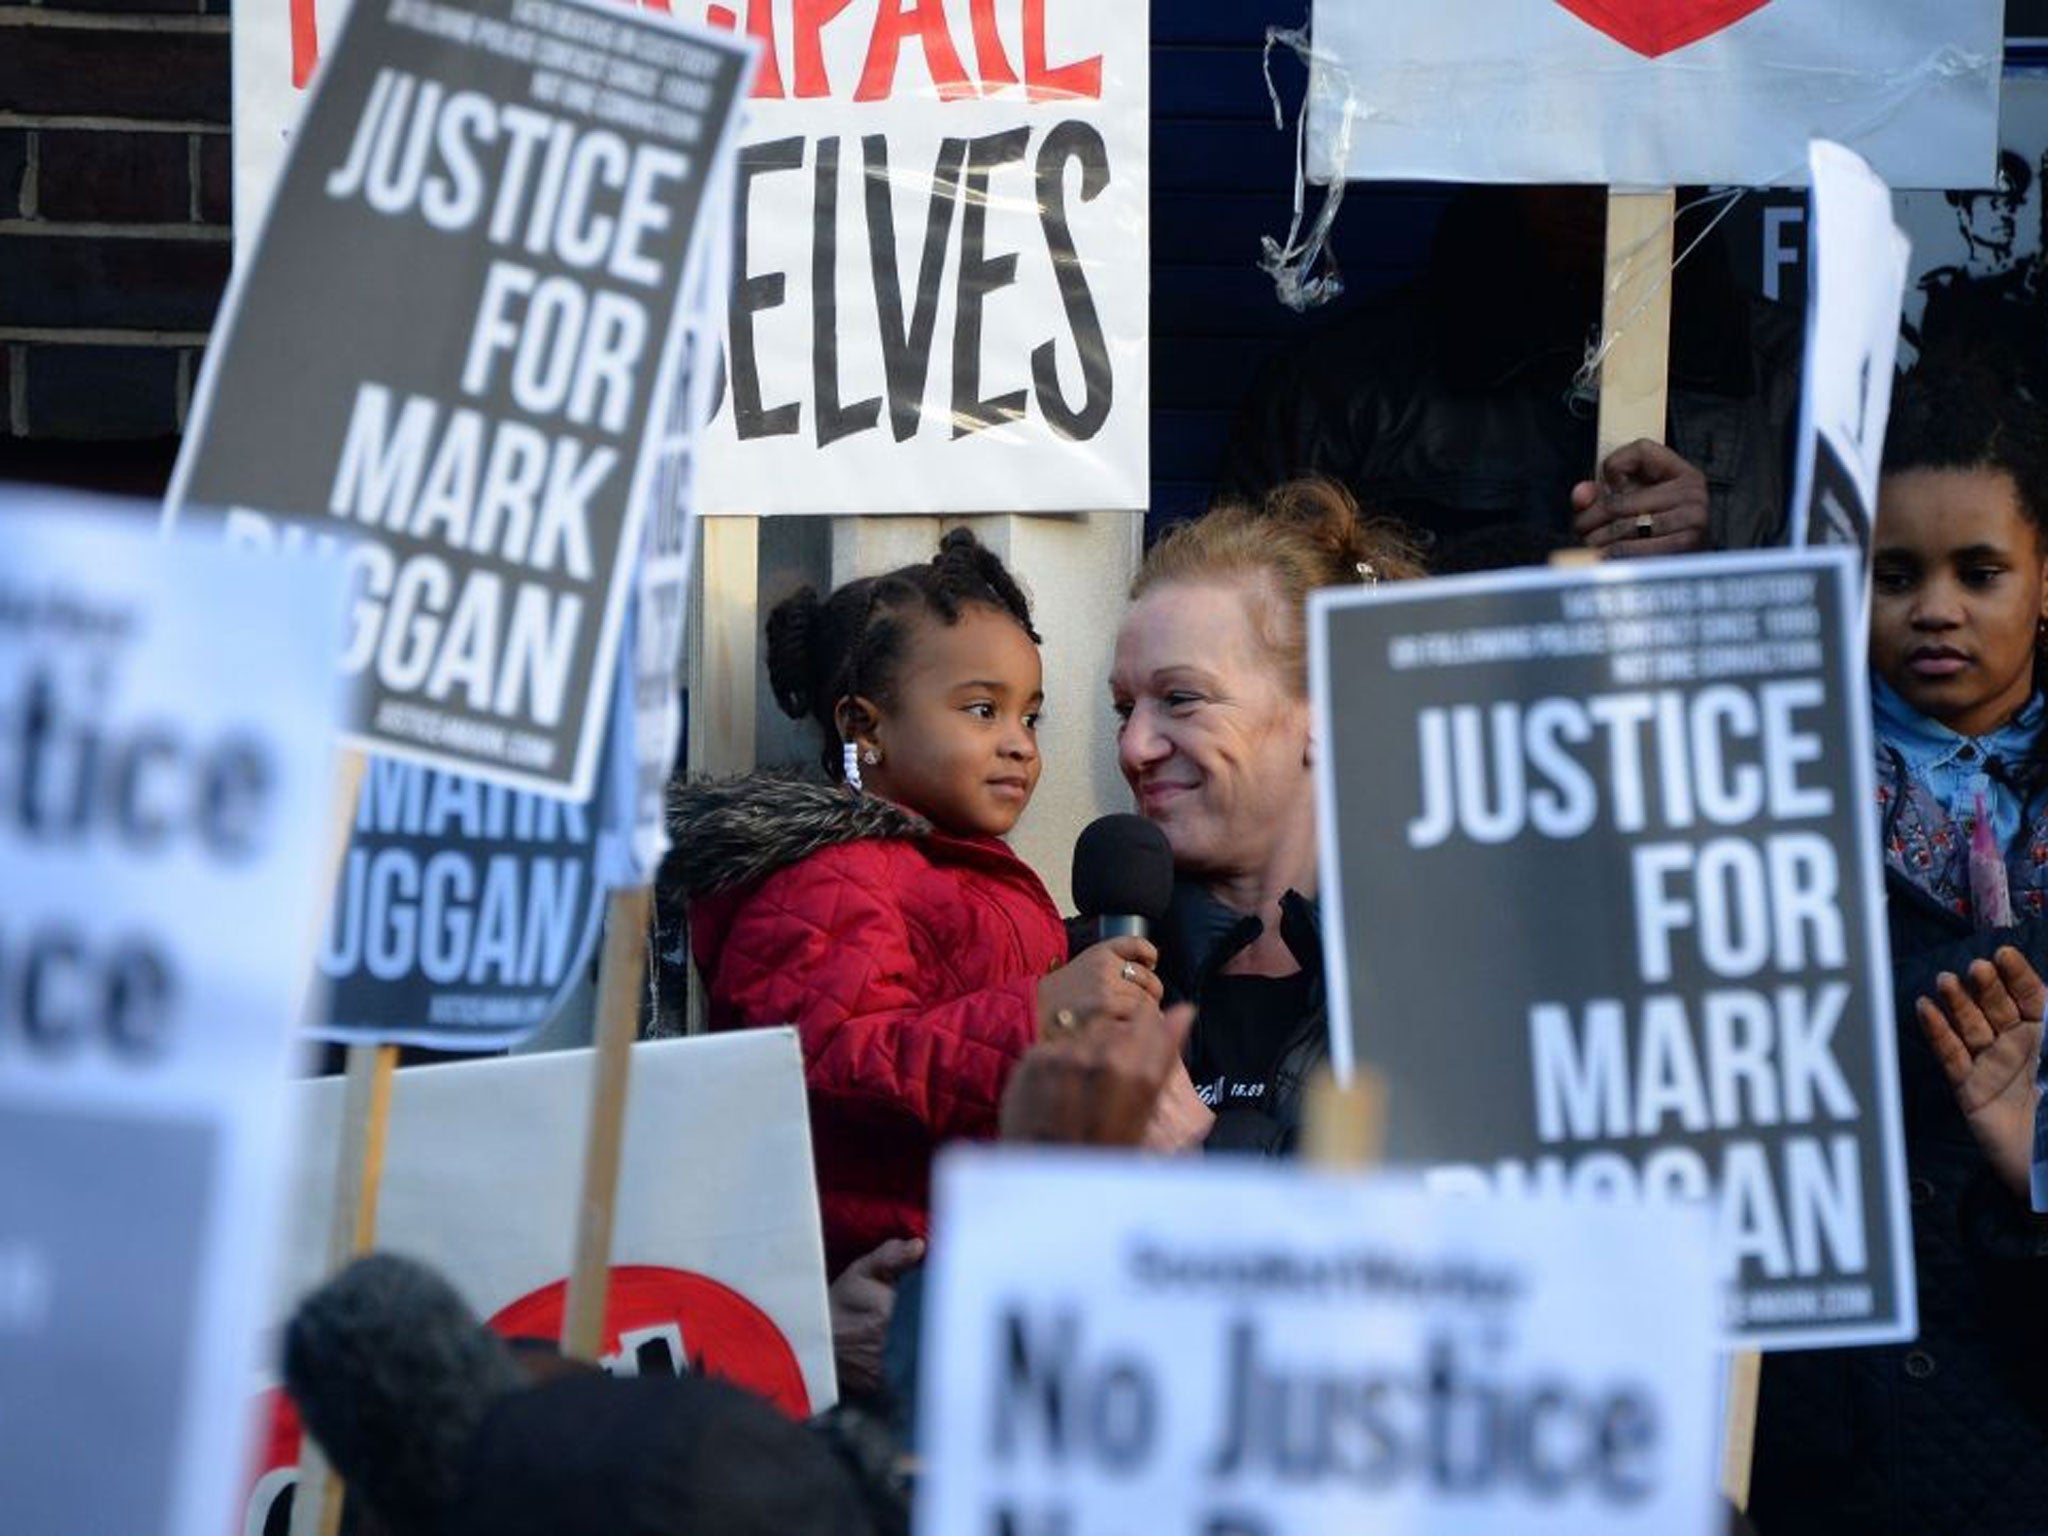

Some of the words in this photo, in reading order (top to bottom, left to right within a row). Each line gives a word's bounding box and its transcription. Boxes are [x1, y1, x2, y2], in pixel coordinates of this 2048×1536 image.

[325, 68, 689, 287] JUSTICE
[461, 259, 649, 435] FOR
[706, 119, 1113, 449] ELVES
[328, 381, 619, 582] MARK
[224, 506, 585, 730] GGAN
[1407, 679, 1835, 849] JUSTICE
[1632, 833, 1847, 983] FOR
[1529, 980, 1861, 1144] MARK
[992, 1290, 1161, 1480] No
[1206, 1308, 1662, 1512] Justice
